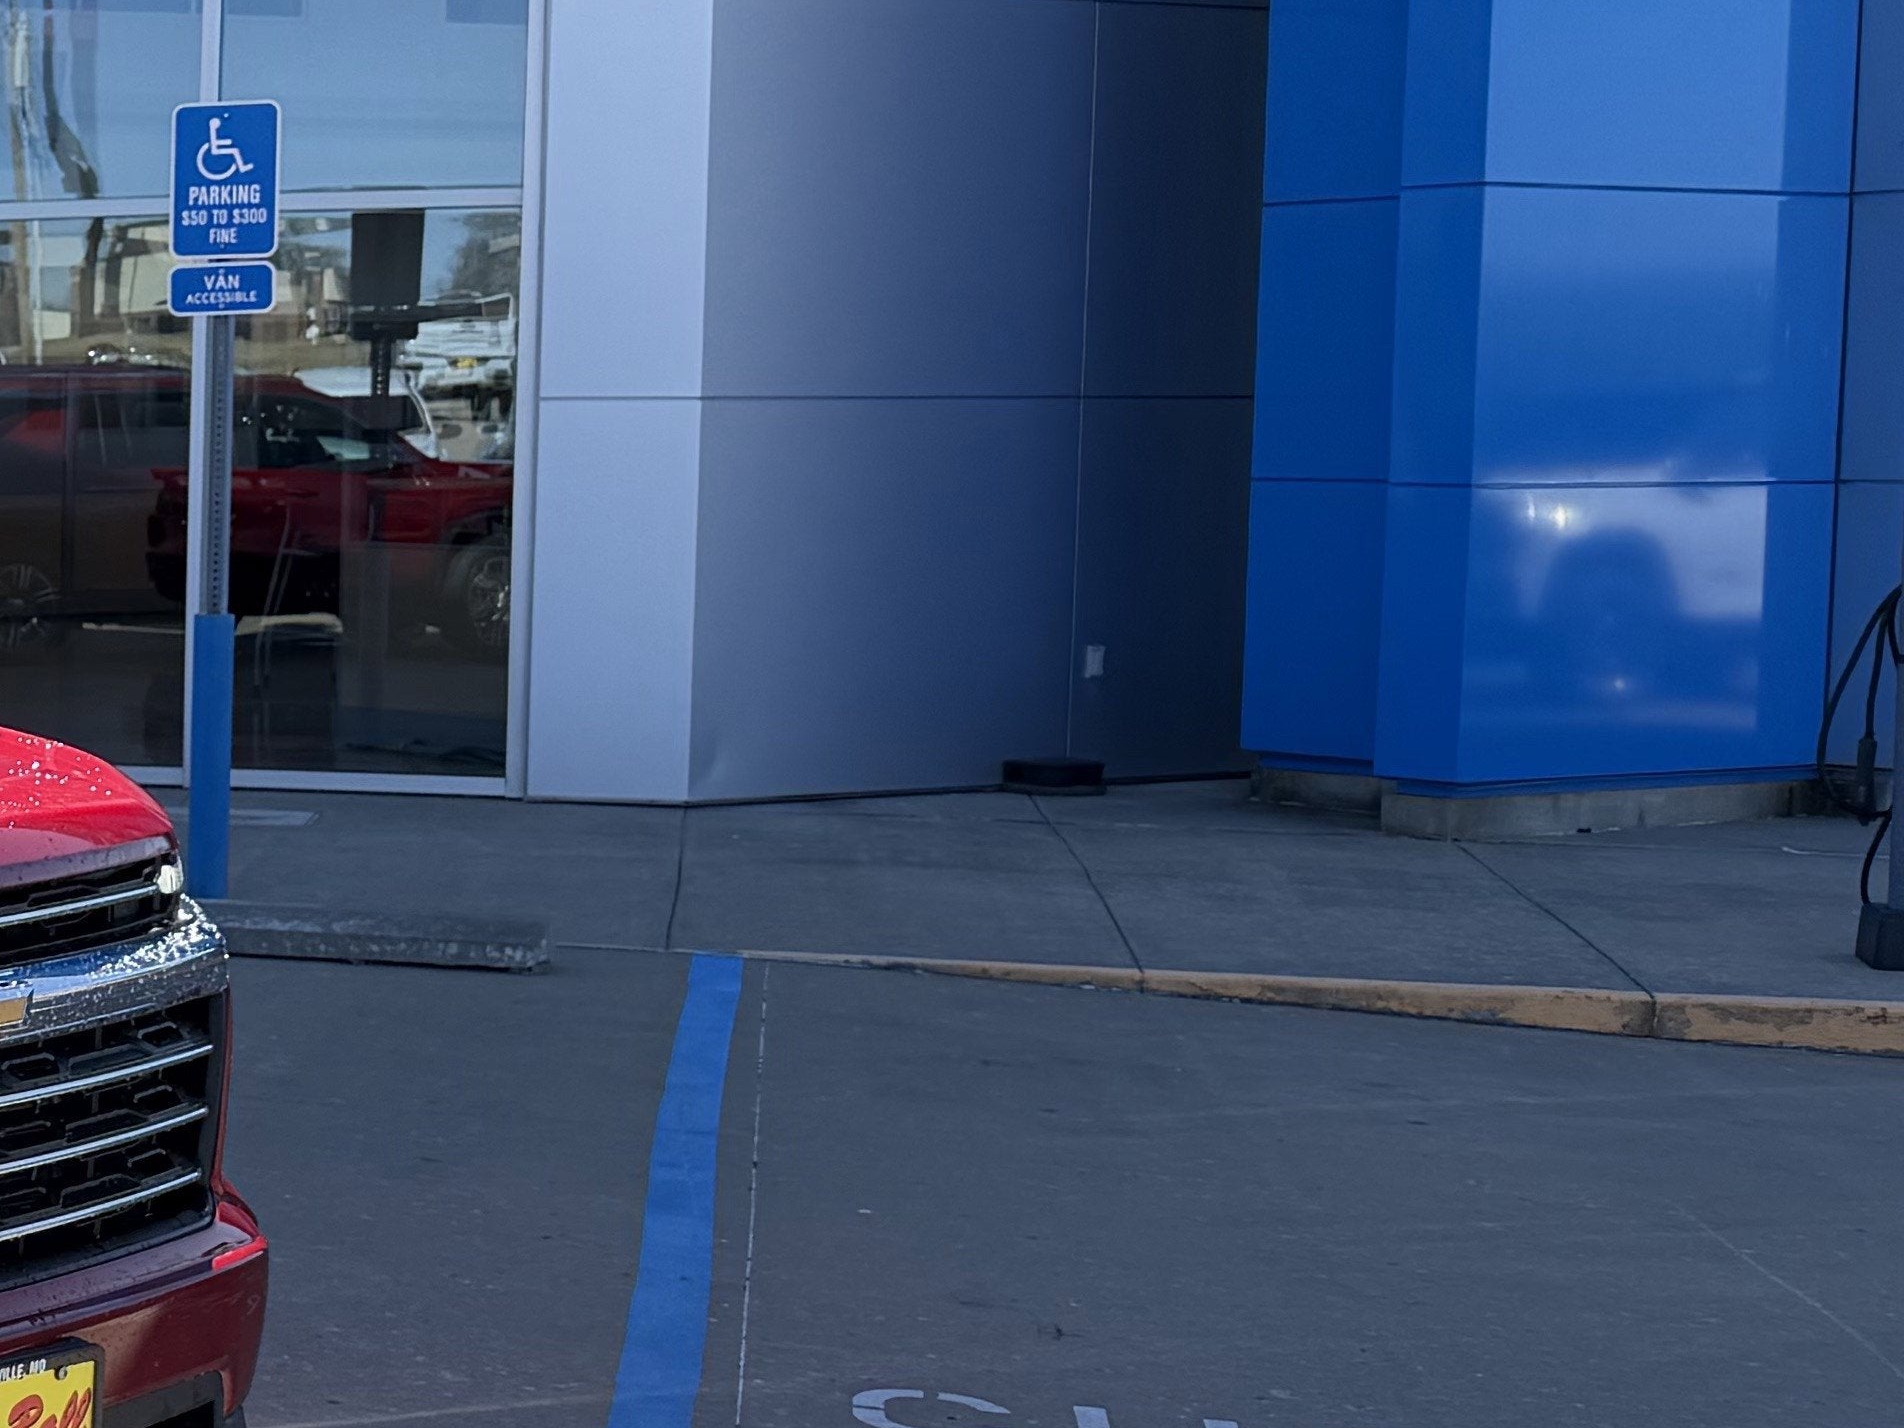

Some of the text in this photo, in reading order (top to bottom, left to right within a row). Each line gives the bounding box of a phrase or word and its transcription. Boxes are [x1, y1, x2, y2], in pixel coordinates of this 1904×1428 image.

[188, 184, 260, 205] PARKING
[181, 208, 267, 226] $50 TO $300
[209, 228, 238, 244] FINE
[204, 274, 240, 290] VAN
[185, 290, 258, 305] ACCESSIBLE
[29, 1358, 47, 1375] MO
